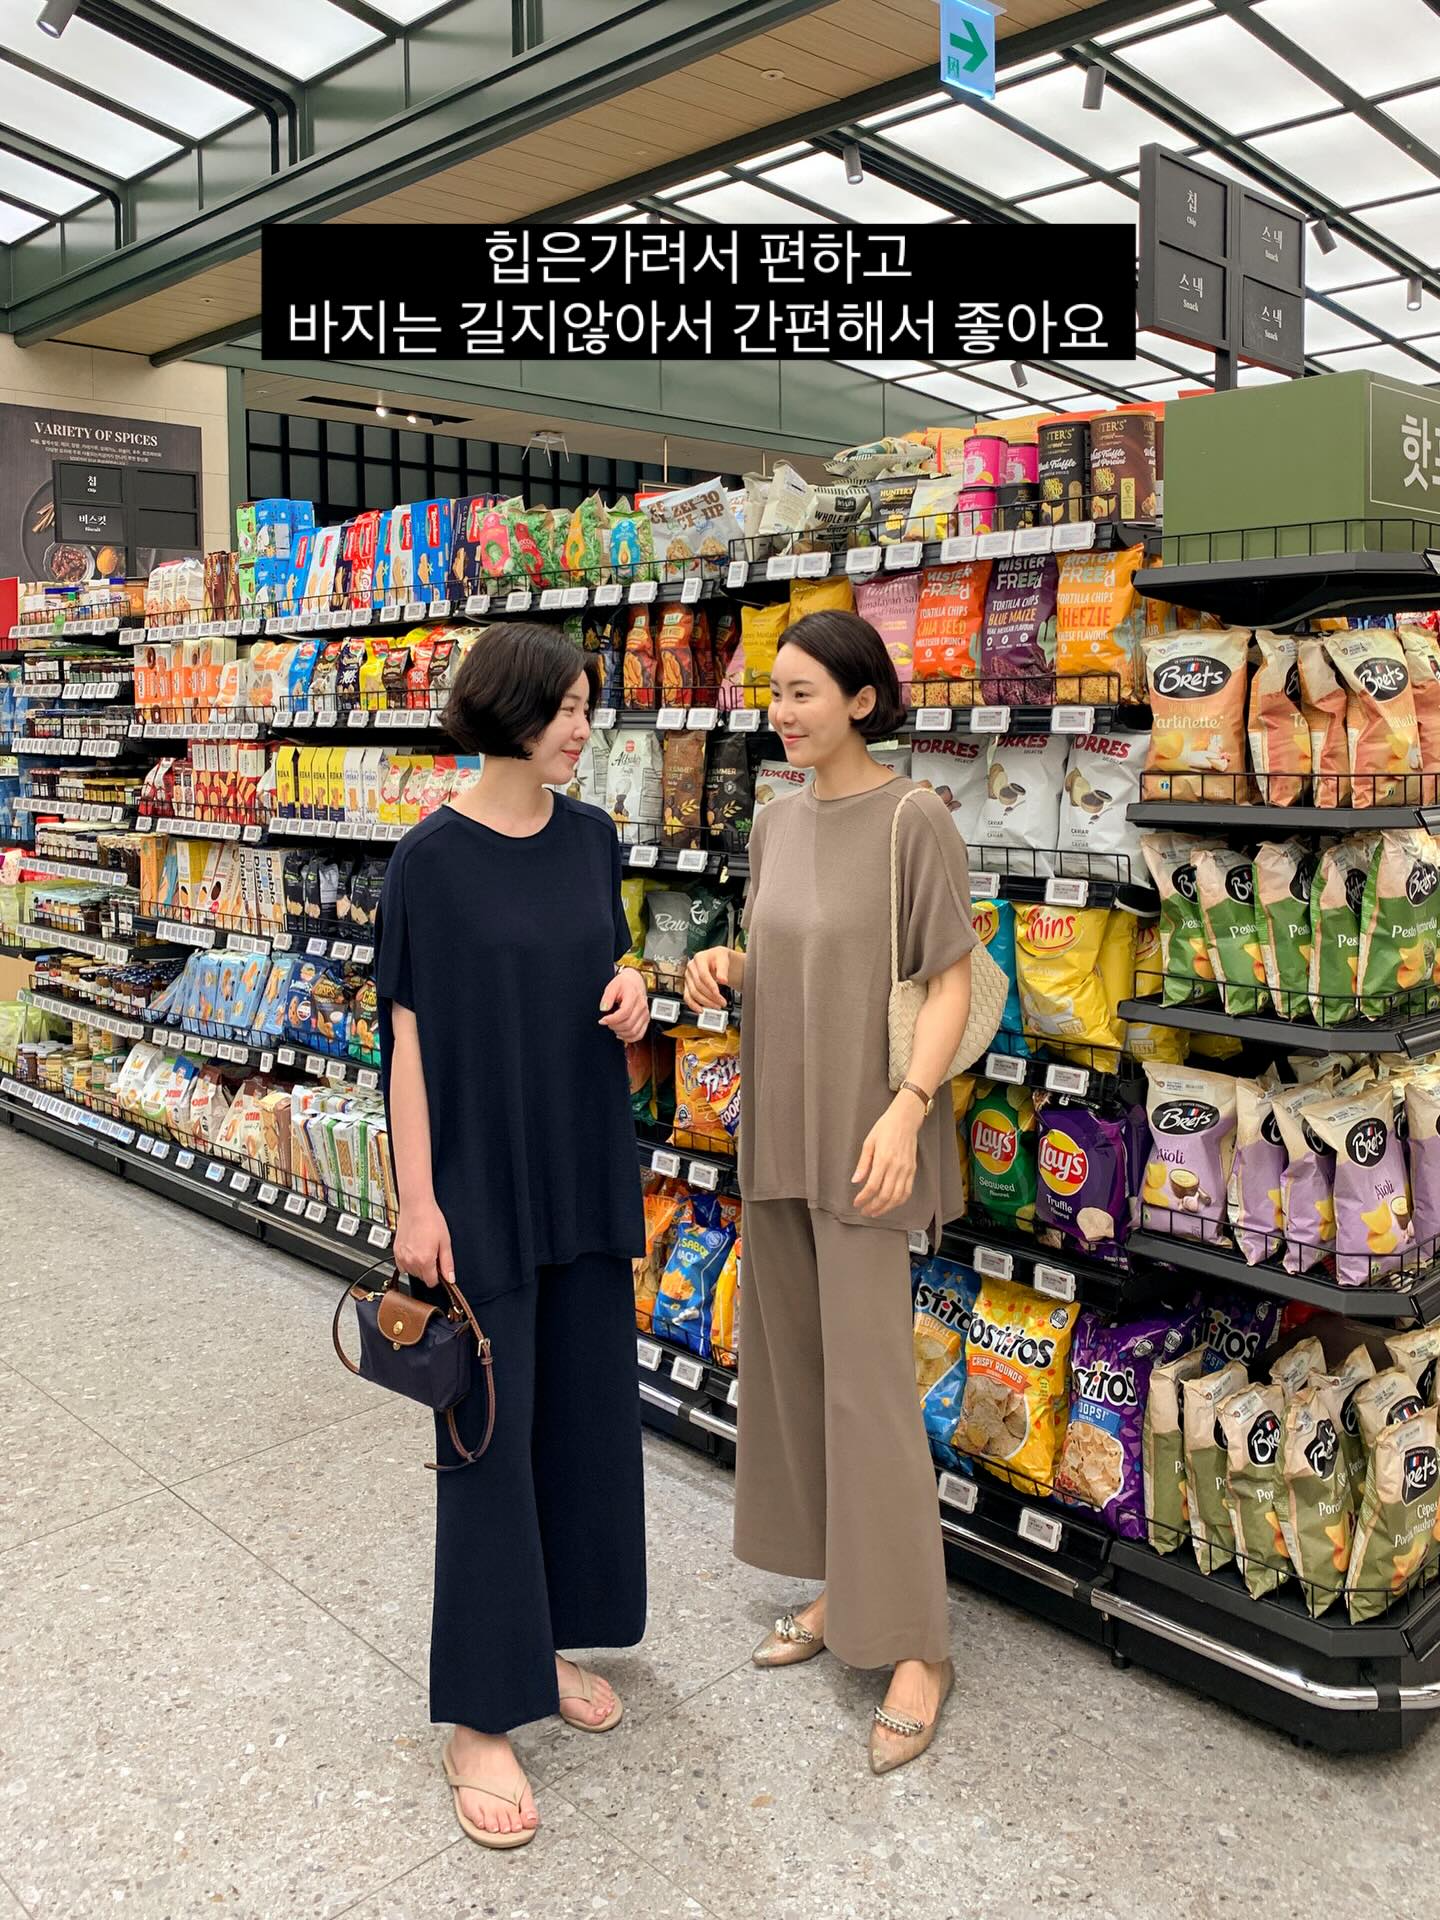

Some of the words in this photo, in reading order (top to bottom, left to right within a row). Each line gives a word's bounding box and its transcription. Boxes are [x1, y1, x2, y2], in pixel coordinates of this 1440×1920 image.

[1186, 190, 1198, 213] 칩
[1261, 226, 1283, 250] 스낵
[1179, 273, 1203, 298] 스낵
[1183, 299, 1199, 312] Snack
[1261, 305, 1282, 328] 스낵
[34, 421, 93, 439] VARIETY
[94, 429, 113, 442] OF
[114, 431, 158, 447] SPICES
[87, 475, 97, 487] 칩
[79, 514, 107, 526] 비스킷
[814, 510, 842, 523] WHOLE
[998, 556, 1045, 572] MISTER
[1063, 552, 1117, 569] MISTER
[927, 564, 974, 581] MISTER
[992, 599, 1020, 611] TORTILLA
[1021, 594, 1039, 607] CHIPS
[1057, 593, 1089, 606] TORTILLA
[1090, 591, 1113, 603] CHIPS
[920, 607, 946, 619] TORTILLA
[947, 605, 968, 617] CHIPS
[988, 612, 1008, 626] BLUE
[1009, 608, 1037, 623] MAIZE
[917, 622, 939, 636] CHIA
[941, 621, 967, 635] SEED
[1159, 664, 1224, 693] Brets
[1358, 665, 1405, 697] Brets
[911, 738, 980, 759] TORRES
[758, 768, 806, 784] TORRES
[254, 856, 264, 903] Diablo
[267, 857, 276, 905] Diablo
[1408, 867, 1438, 901] Brets
[655, 913, 690, 932] Raw
[1158, 1106, 1213, 1132] Brets
[974, 1121, 1013, 1161] Lay's
[1352, 1127, 1384, 1163] Brets
[1040, 1138, 1084, 1181] Lay's
[1156, 1148, 1185, 1165] Aïoli
[978, 1176, 1016, 1193] Seaweed
[1374, 1178, 1395, 1200] Aïoli
[1046, 1193, 1073, 1214] Truffle
[971, 1356, 994, 1369] CRISPY
[994, 1361, 1024, 1384] ROUNDS
